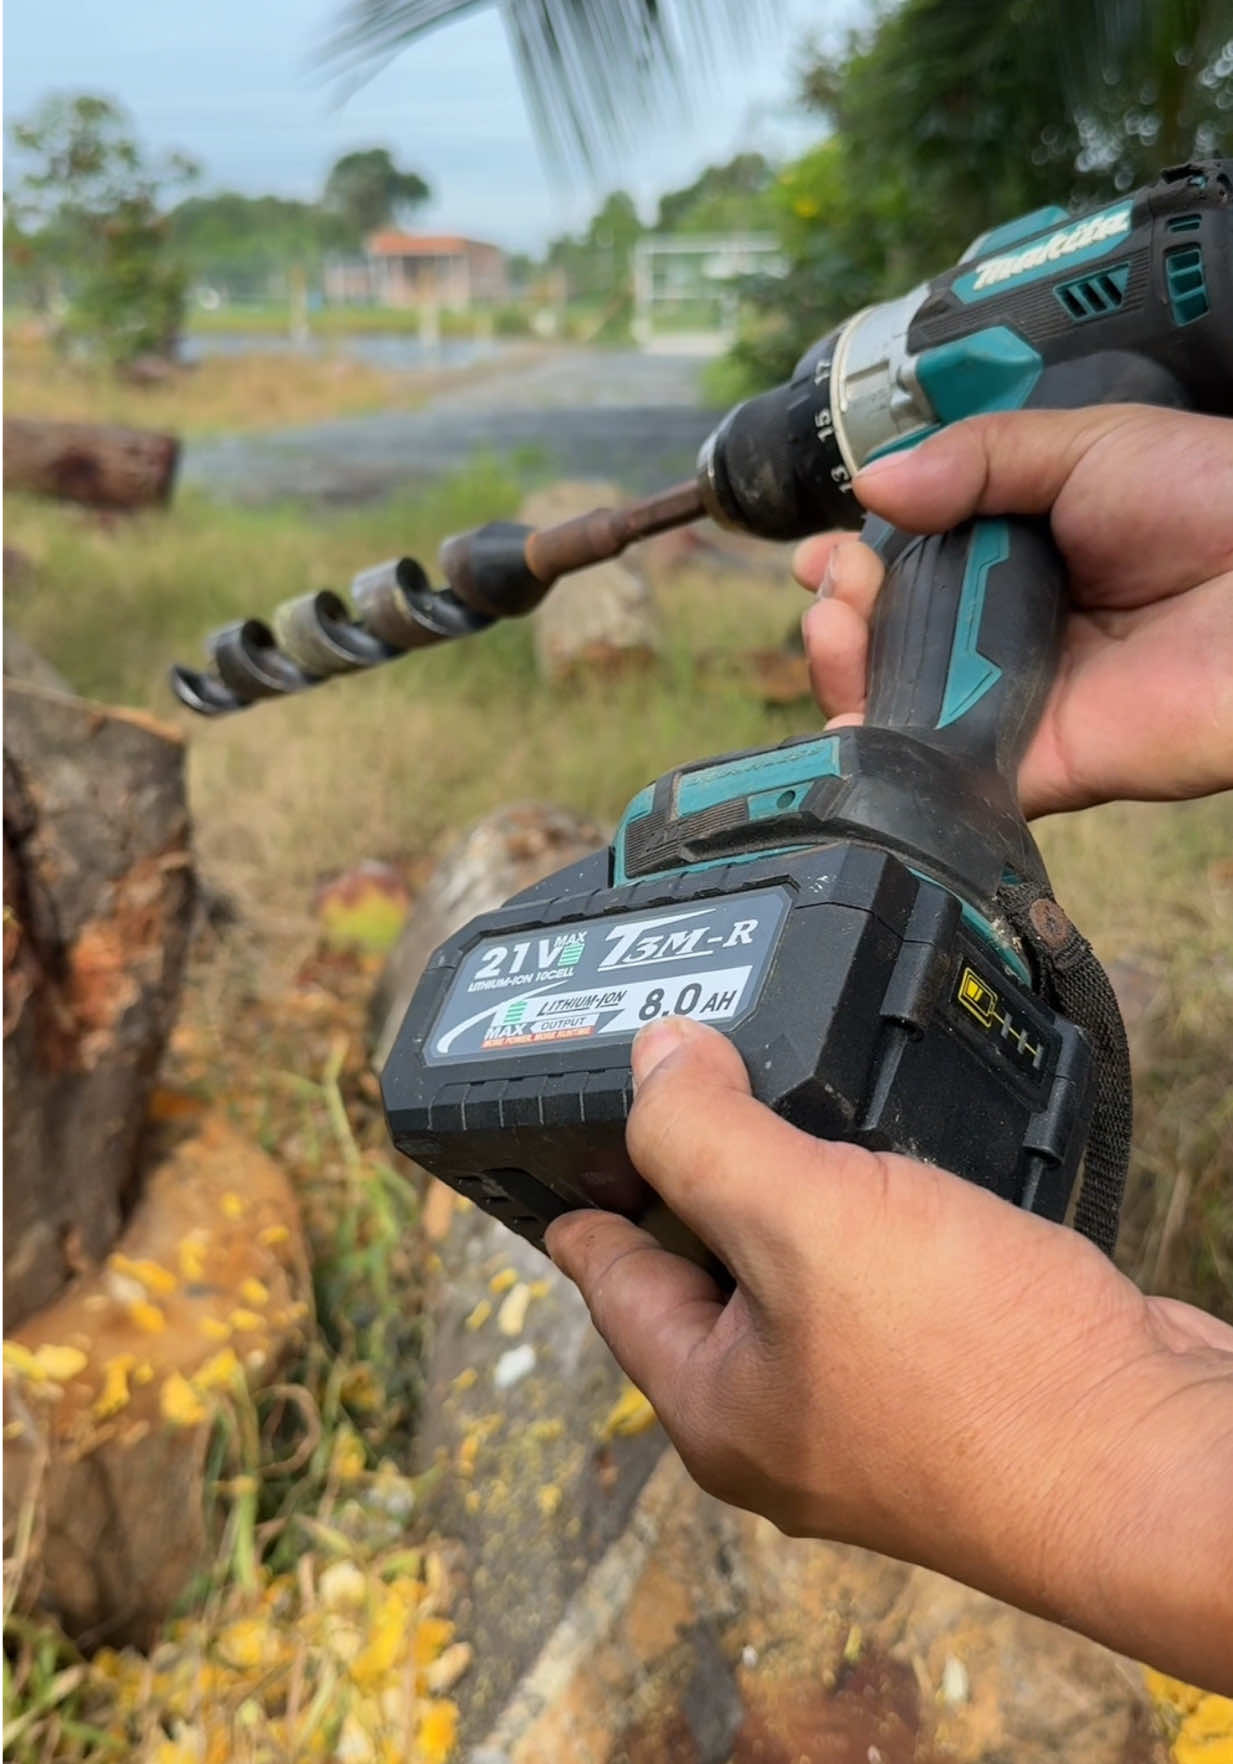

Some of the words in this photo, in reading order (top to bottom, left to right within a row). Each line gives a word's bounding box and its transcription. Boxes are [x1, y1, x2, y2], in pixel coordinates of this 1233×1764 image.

[814, 407, 835, 443] 15
[830, 463, 853, 494] 13
[553, 930, 588, 948] MAX
[467, 973, 534, 993] LITHIUM-ION
[536, 989, 628, 1017] LITHIUM-ION
[700, 990, 737, 1014] AH
[484, 1023, 528, 1041] MAX
[540, 1016, 587, 1031] OUTPUT
